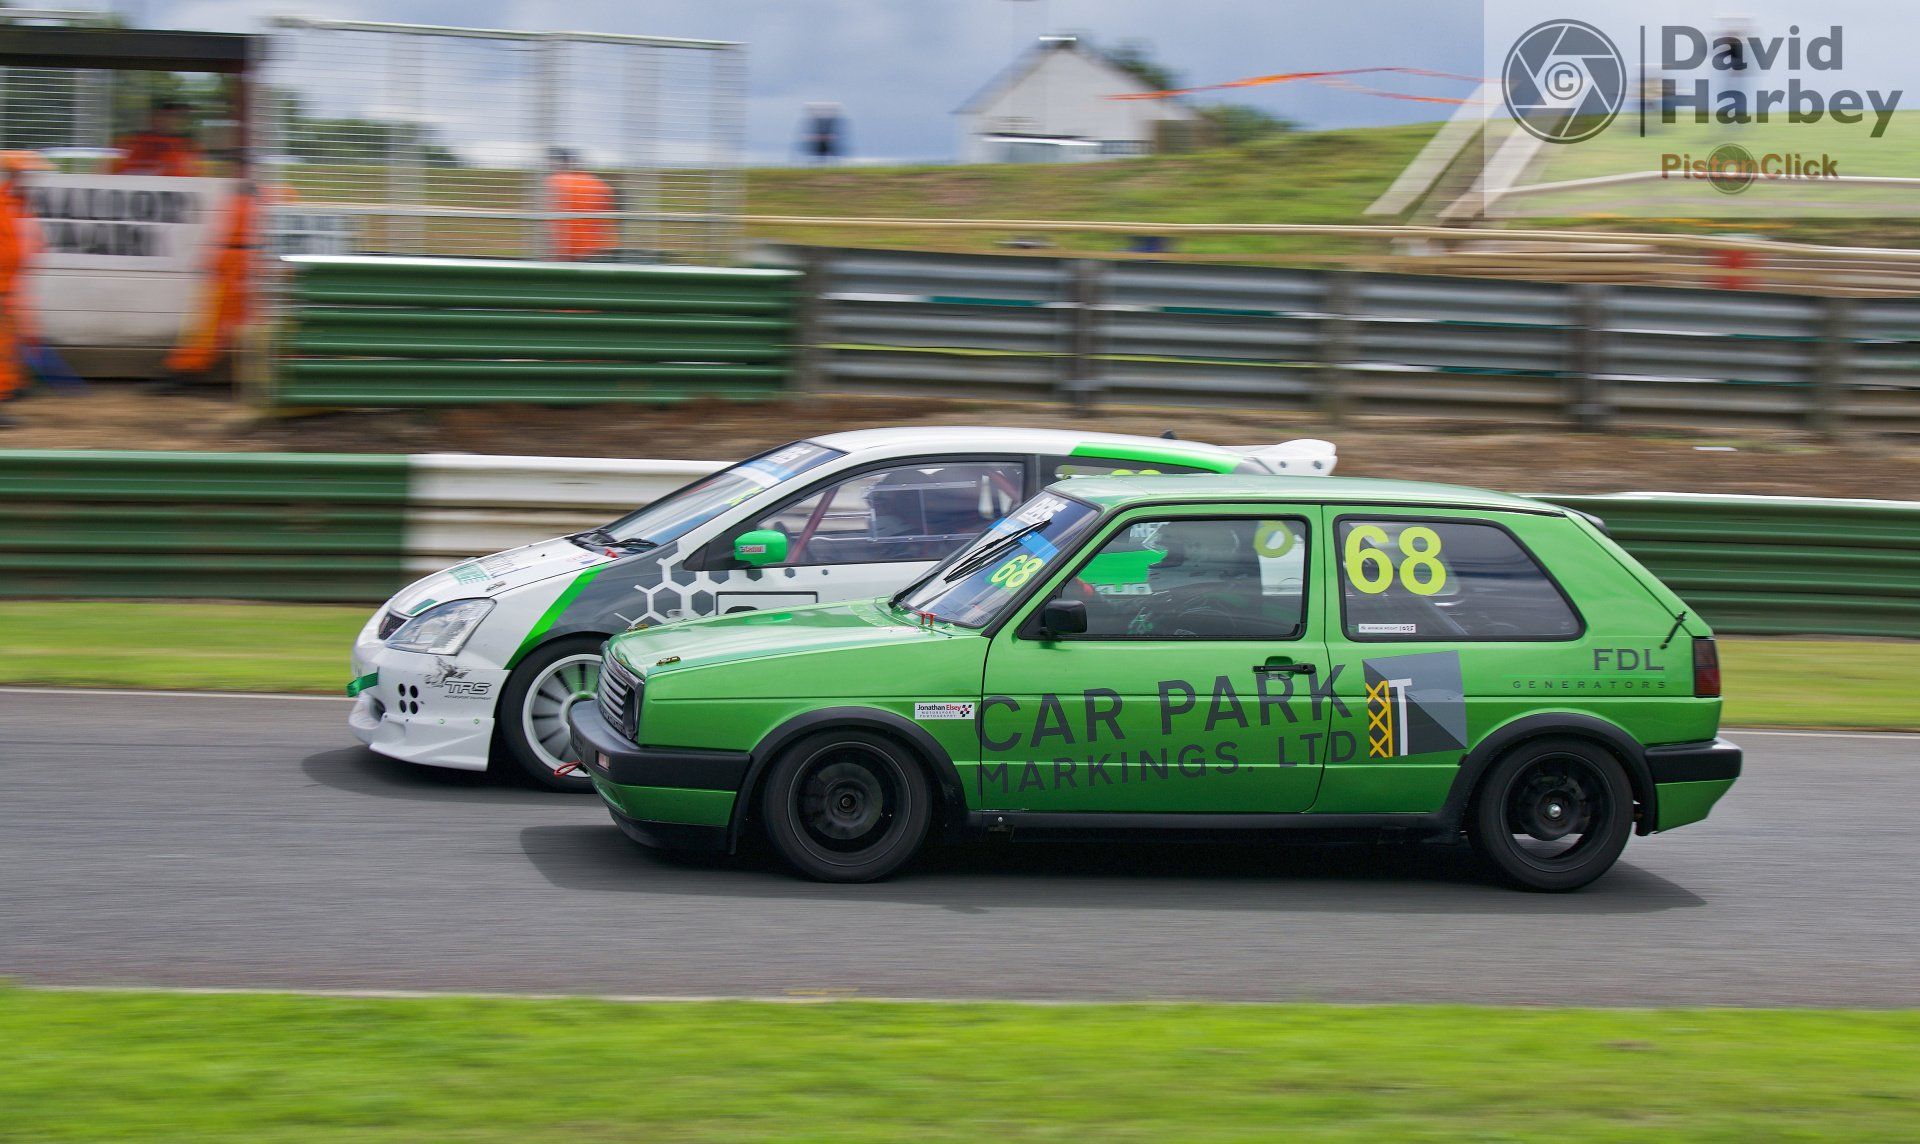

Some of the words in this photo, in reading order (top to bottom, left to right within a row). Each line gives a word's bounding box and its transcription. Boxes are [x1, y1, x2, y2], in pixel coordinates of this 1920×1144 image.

[991, 554, 1043, 588] 68
[1345, 525, 1447, 595] 68
[1593, 648, 1665, 671] FDL
[445, 680, 492, 695] TRS
[1512, 680, 1666, 689] GENERATORS
[946, 704, 961, 712] Elsey
[974, 687, 1127, 752] CAR
[1157, 664, 1353, 736] PARK
[975, 740, 1255, 796] MARKINGS.
[1277, 730, 1357, 769] LTD
